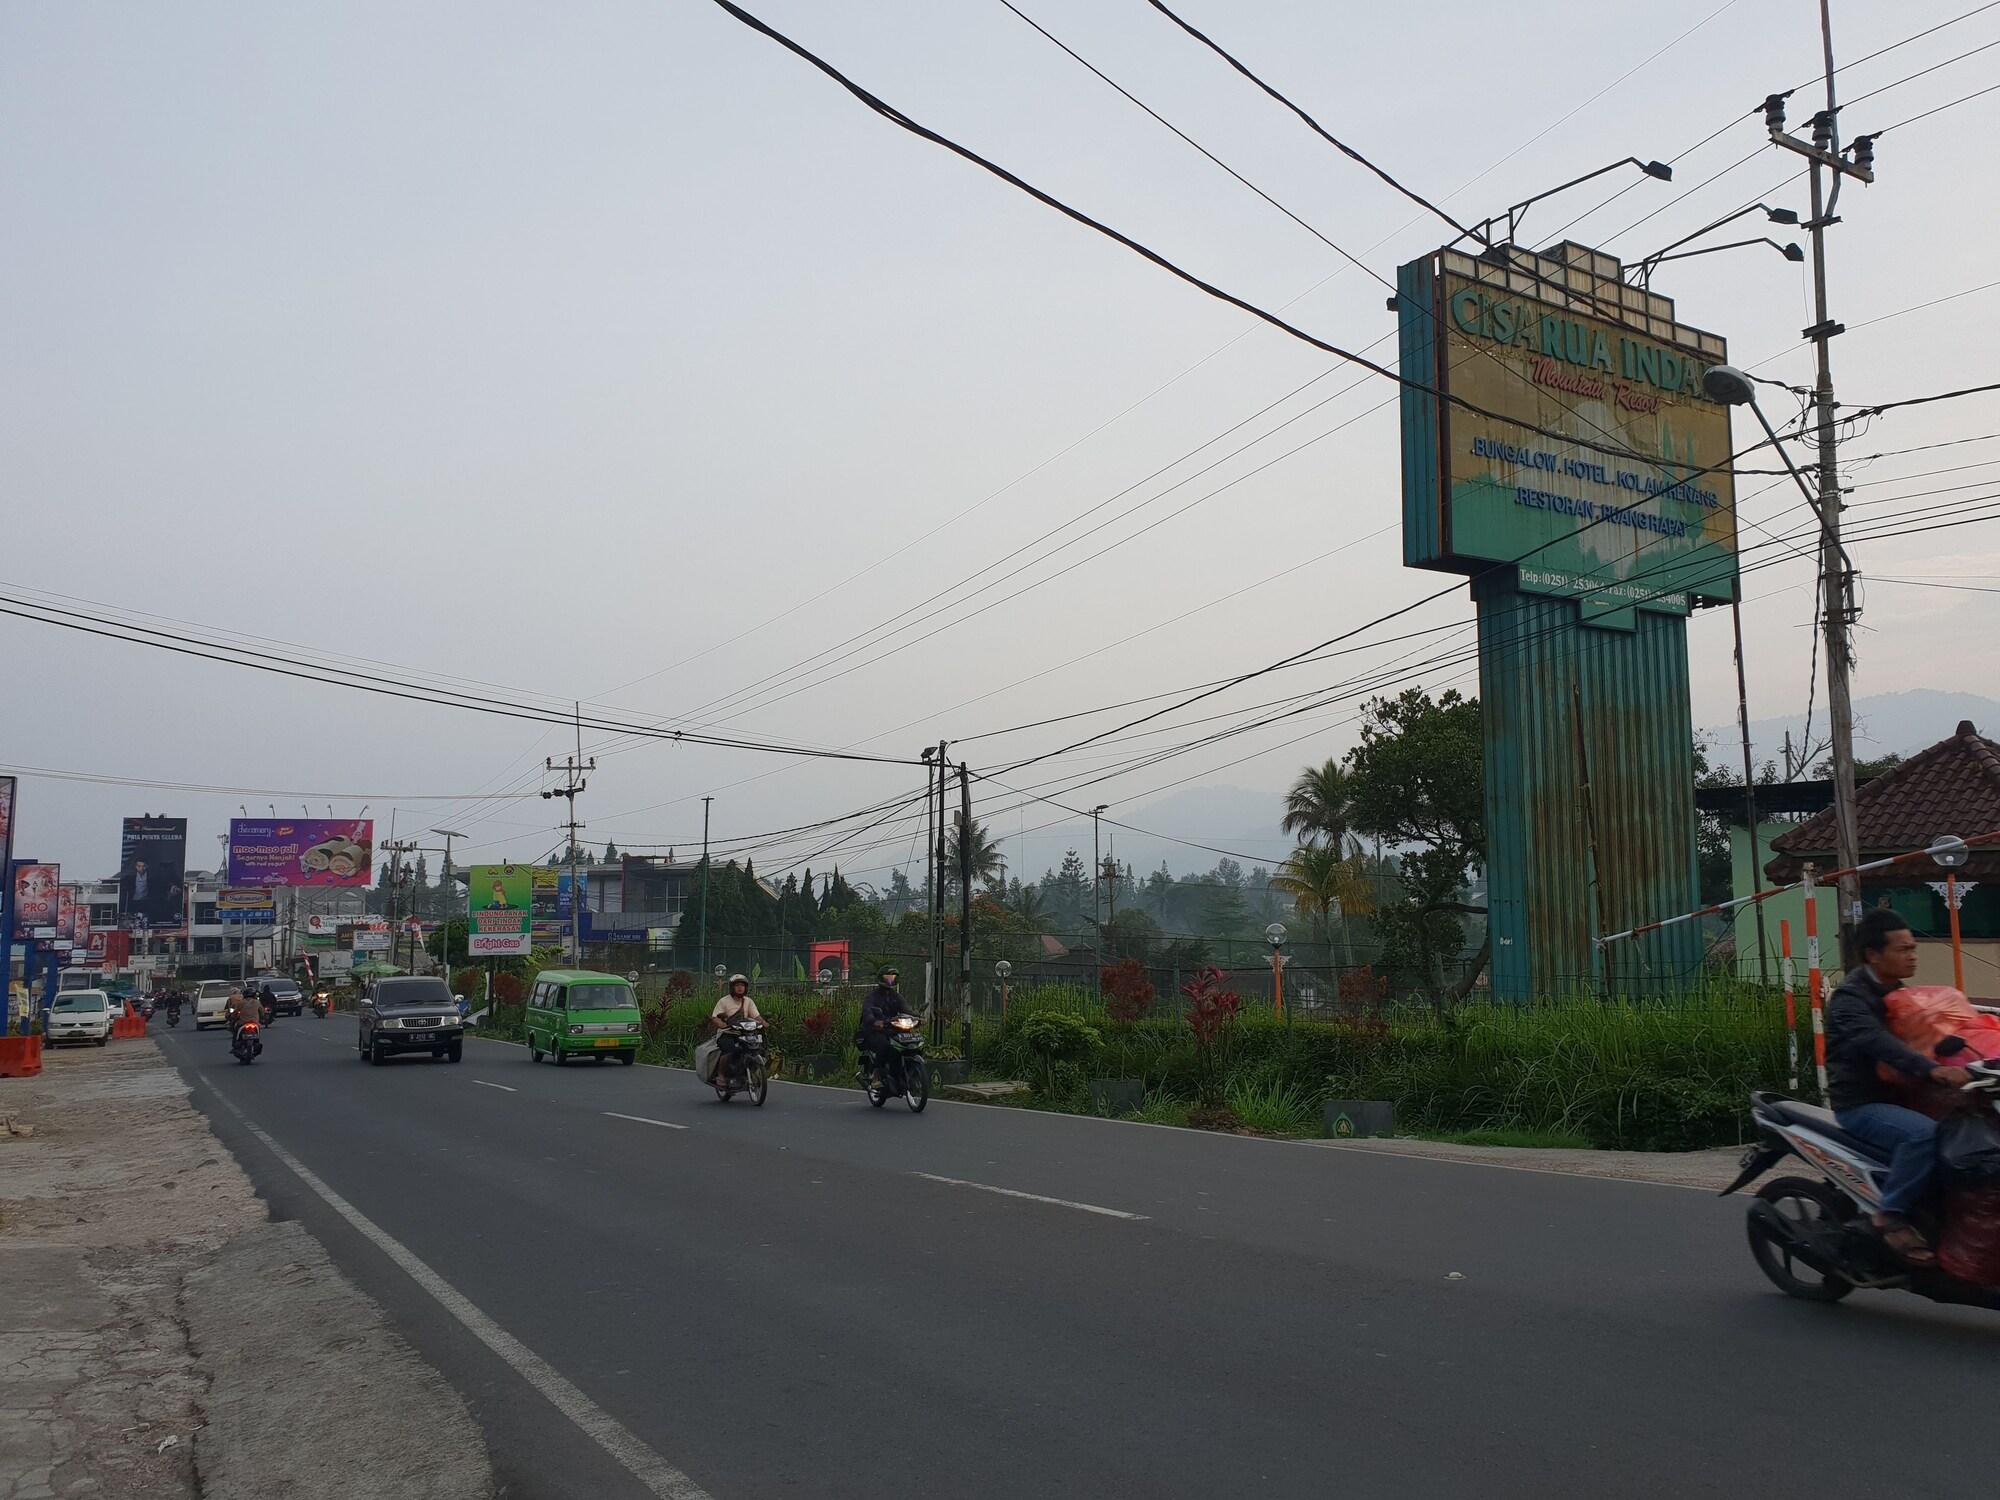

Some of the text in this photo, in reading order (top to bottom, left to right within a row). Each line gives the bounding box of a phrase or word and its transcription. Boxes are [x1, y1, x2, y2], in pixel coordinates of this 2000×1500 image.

[1450, 288, 1614, 375] CISARUA
[1529, 356, 1660, 416] Mountain Resort
[23, 903, 48, 912] PRO
[474, 938, 520, 950] Bright Gas
